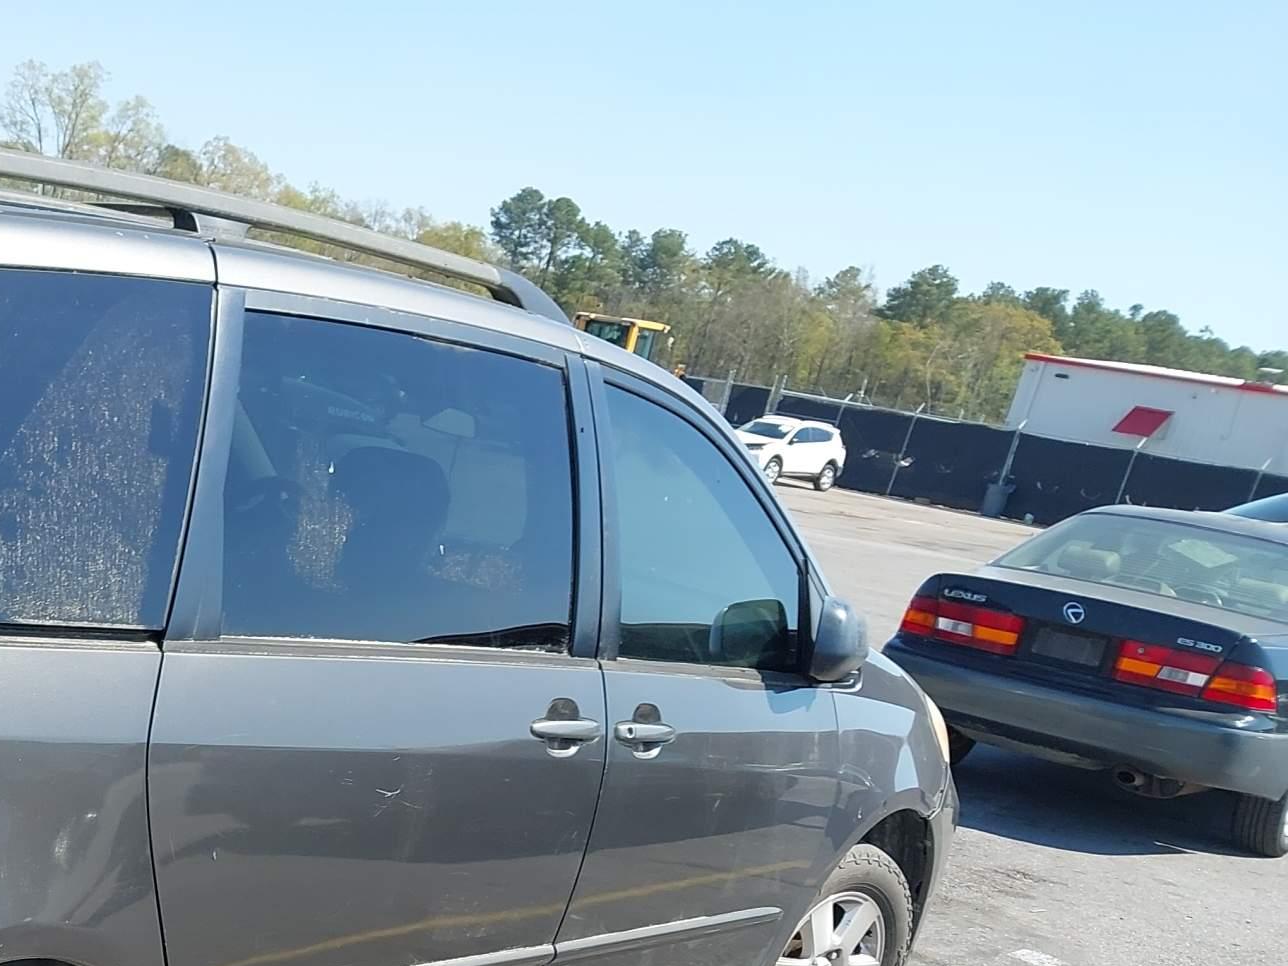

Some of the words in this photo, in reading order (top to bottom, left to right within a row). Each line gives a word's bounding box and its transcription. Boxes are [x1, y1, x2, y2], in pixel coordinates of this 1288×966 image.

[943, 588, 988, 602] LEXUS
[1177, 637, 1194, 647] ES
[1195, 641, 1223, 653] 300
